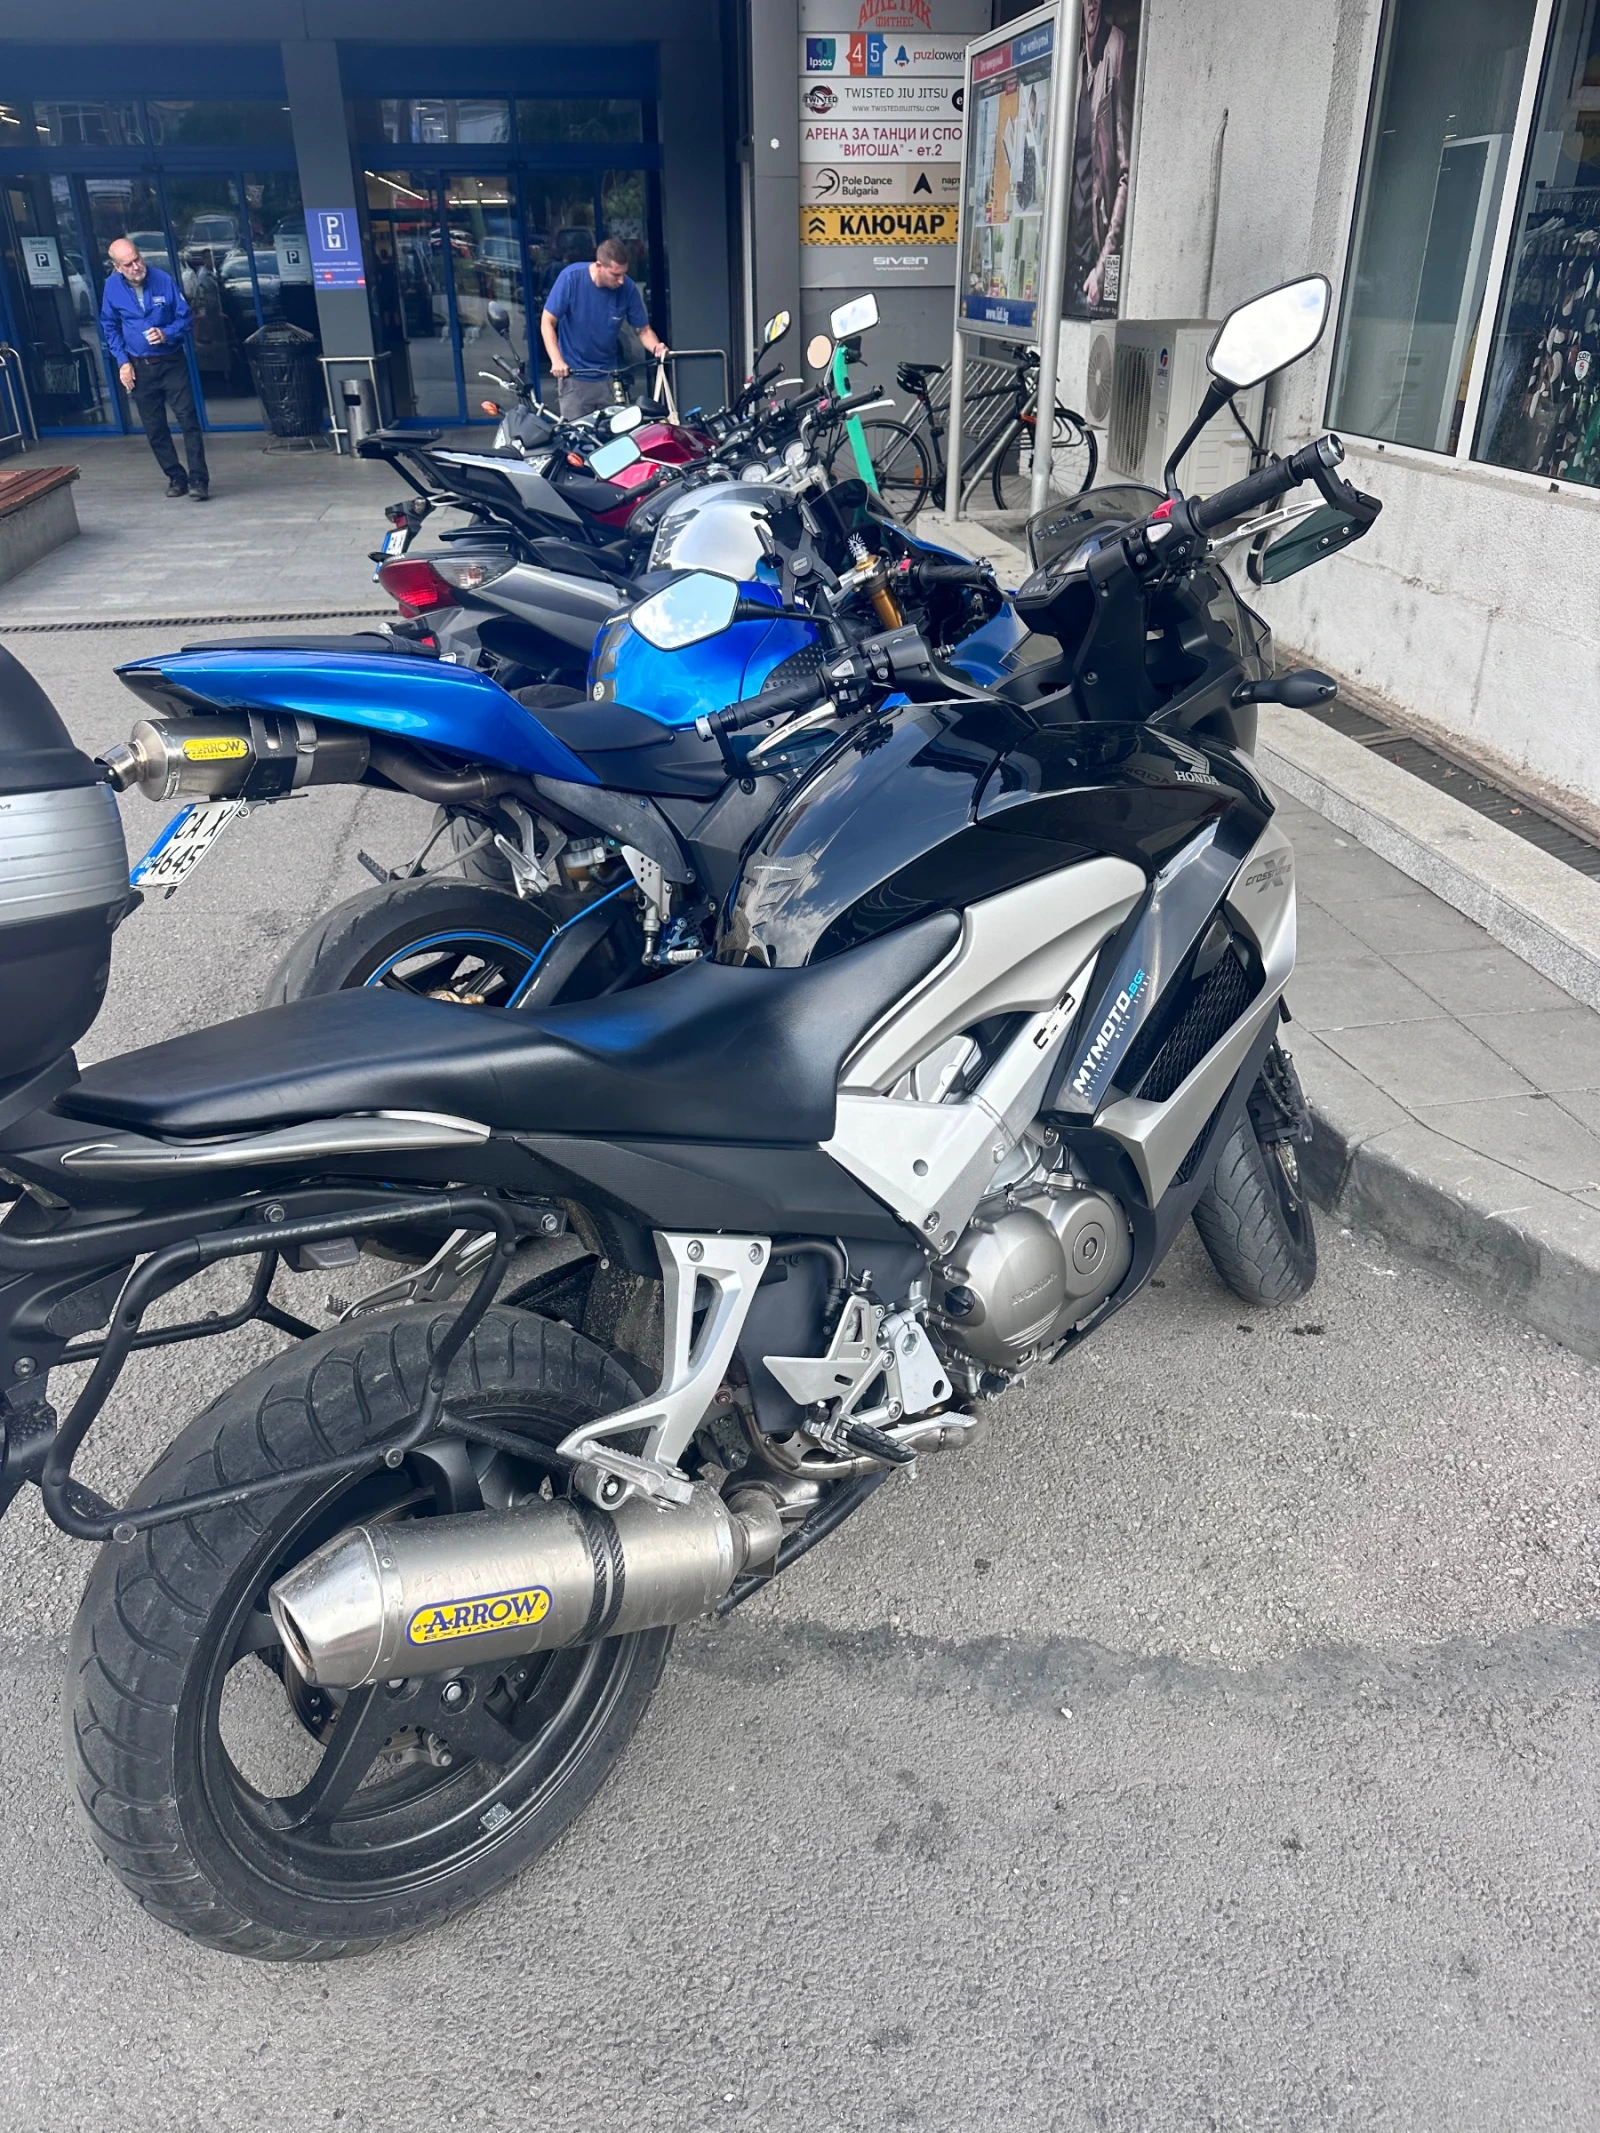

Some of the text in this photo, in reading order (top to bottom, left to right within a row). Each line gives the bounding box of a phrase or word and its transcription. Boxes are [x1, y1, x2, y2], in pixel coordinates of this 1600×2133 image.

[852, 43, 862, 62] 4
[870, 43, 880, 62] 5
[809, 57, 832, 67] Ipsos
[844, 88, 948, 98] TWISTED JIU JITSU
[805, 128, 848, 140] АРЕНА
[852, 128, 869, 140] ЗА
[874, 128, 916, 142] ТАНЦИ
[920, 128, 929, 140] И
[839, 144, 904, 156] "ВИТОША"
[842, 176, 893, 185] Pole Dance
[842, 186, 879, 197] Bulgaria
[326, 216, 339, 234] P
[840, 214, 945, 235] КЛЮЧАР
[1174, 770, 1220, 786] HONDA
[174, 811, 209, 839] CA
[151, 844, 205, 875] 4645
[423, 1593, 541, 1634] ARROW
[424, 1616, 536, 1640] EXHAUST
